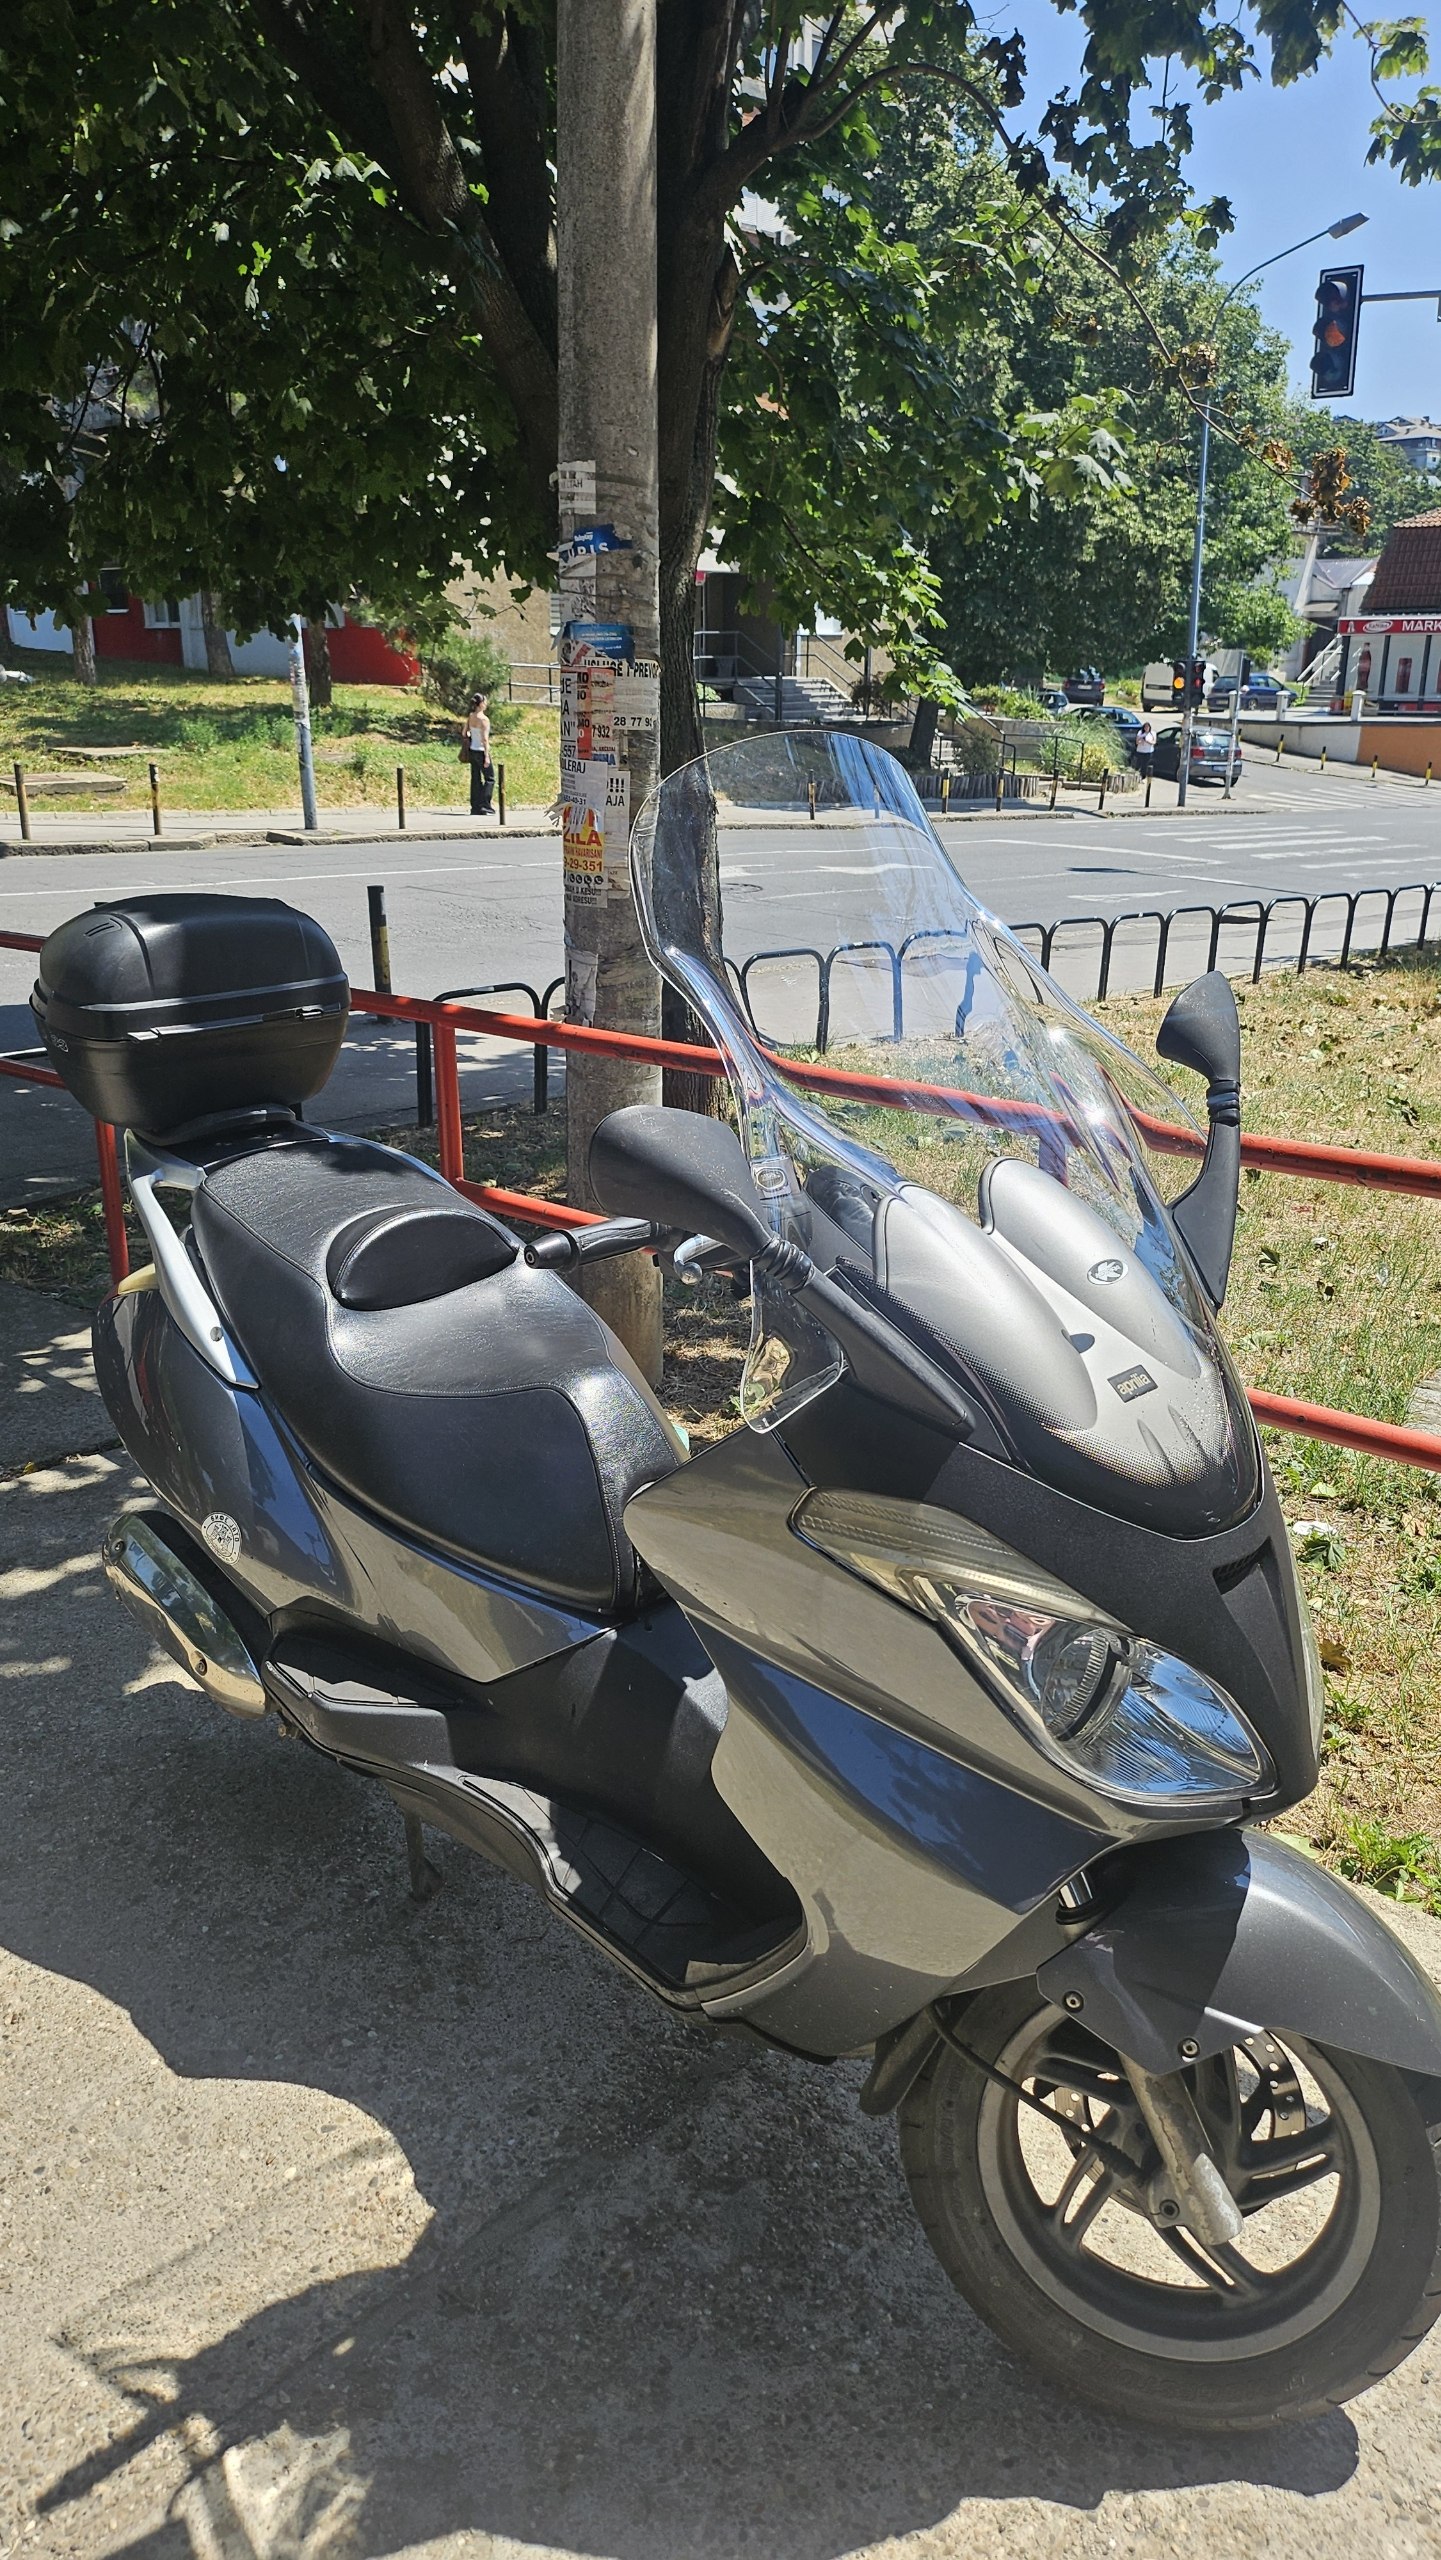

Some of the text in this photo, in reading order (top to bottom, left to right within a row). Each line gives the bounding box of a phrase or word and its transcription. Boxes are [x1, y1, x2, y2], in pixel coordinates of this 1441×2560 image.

[613, 716, 627, 726] 28
[630, 717, 642, 727] 77
[1117, 1373, 1150, 1395] aprilia
